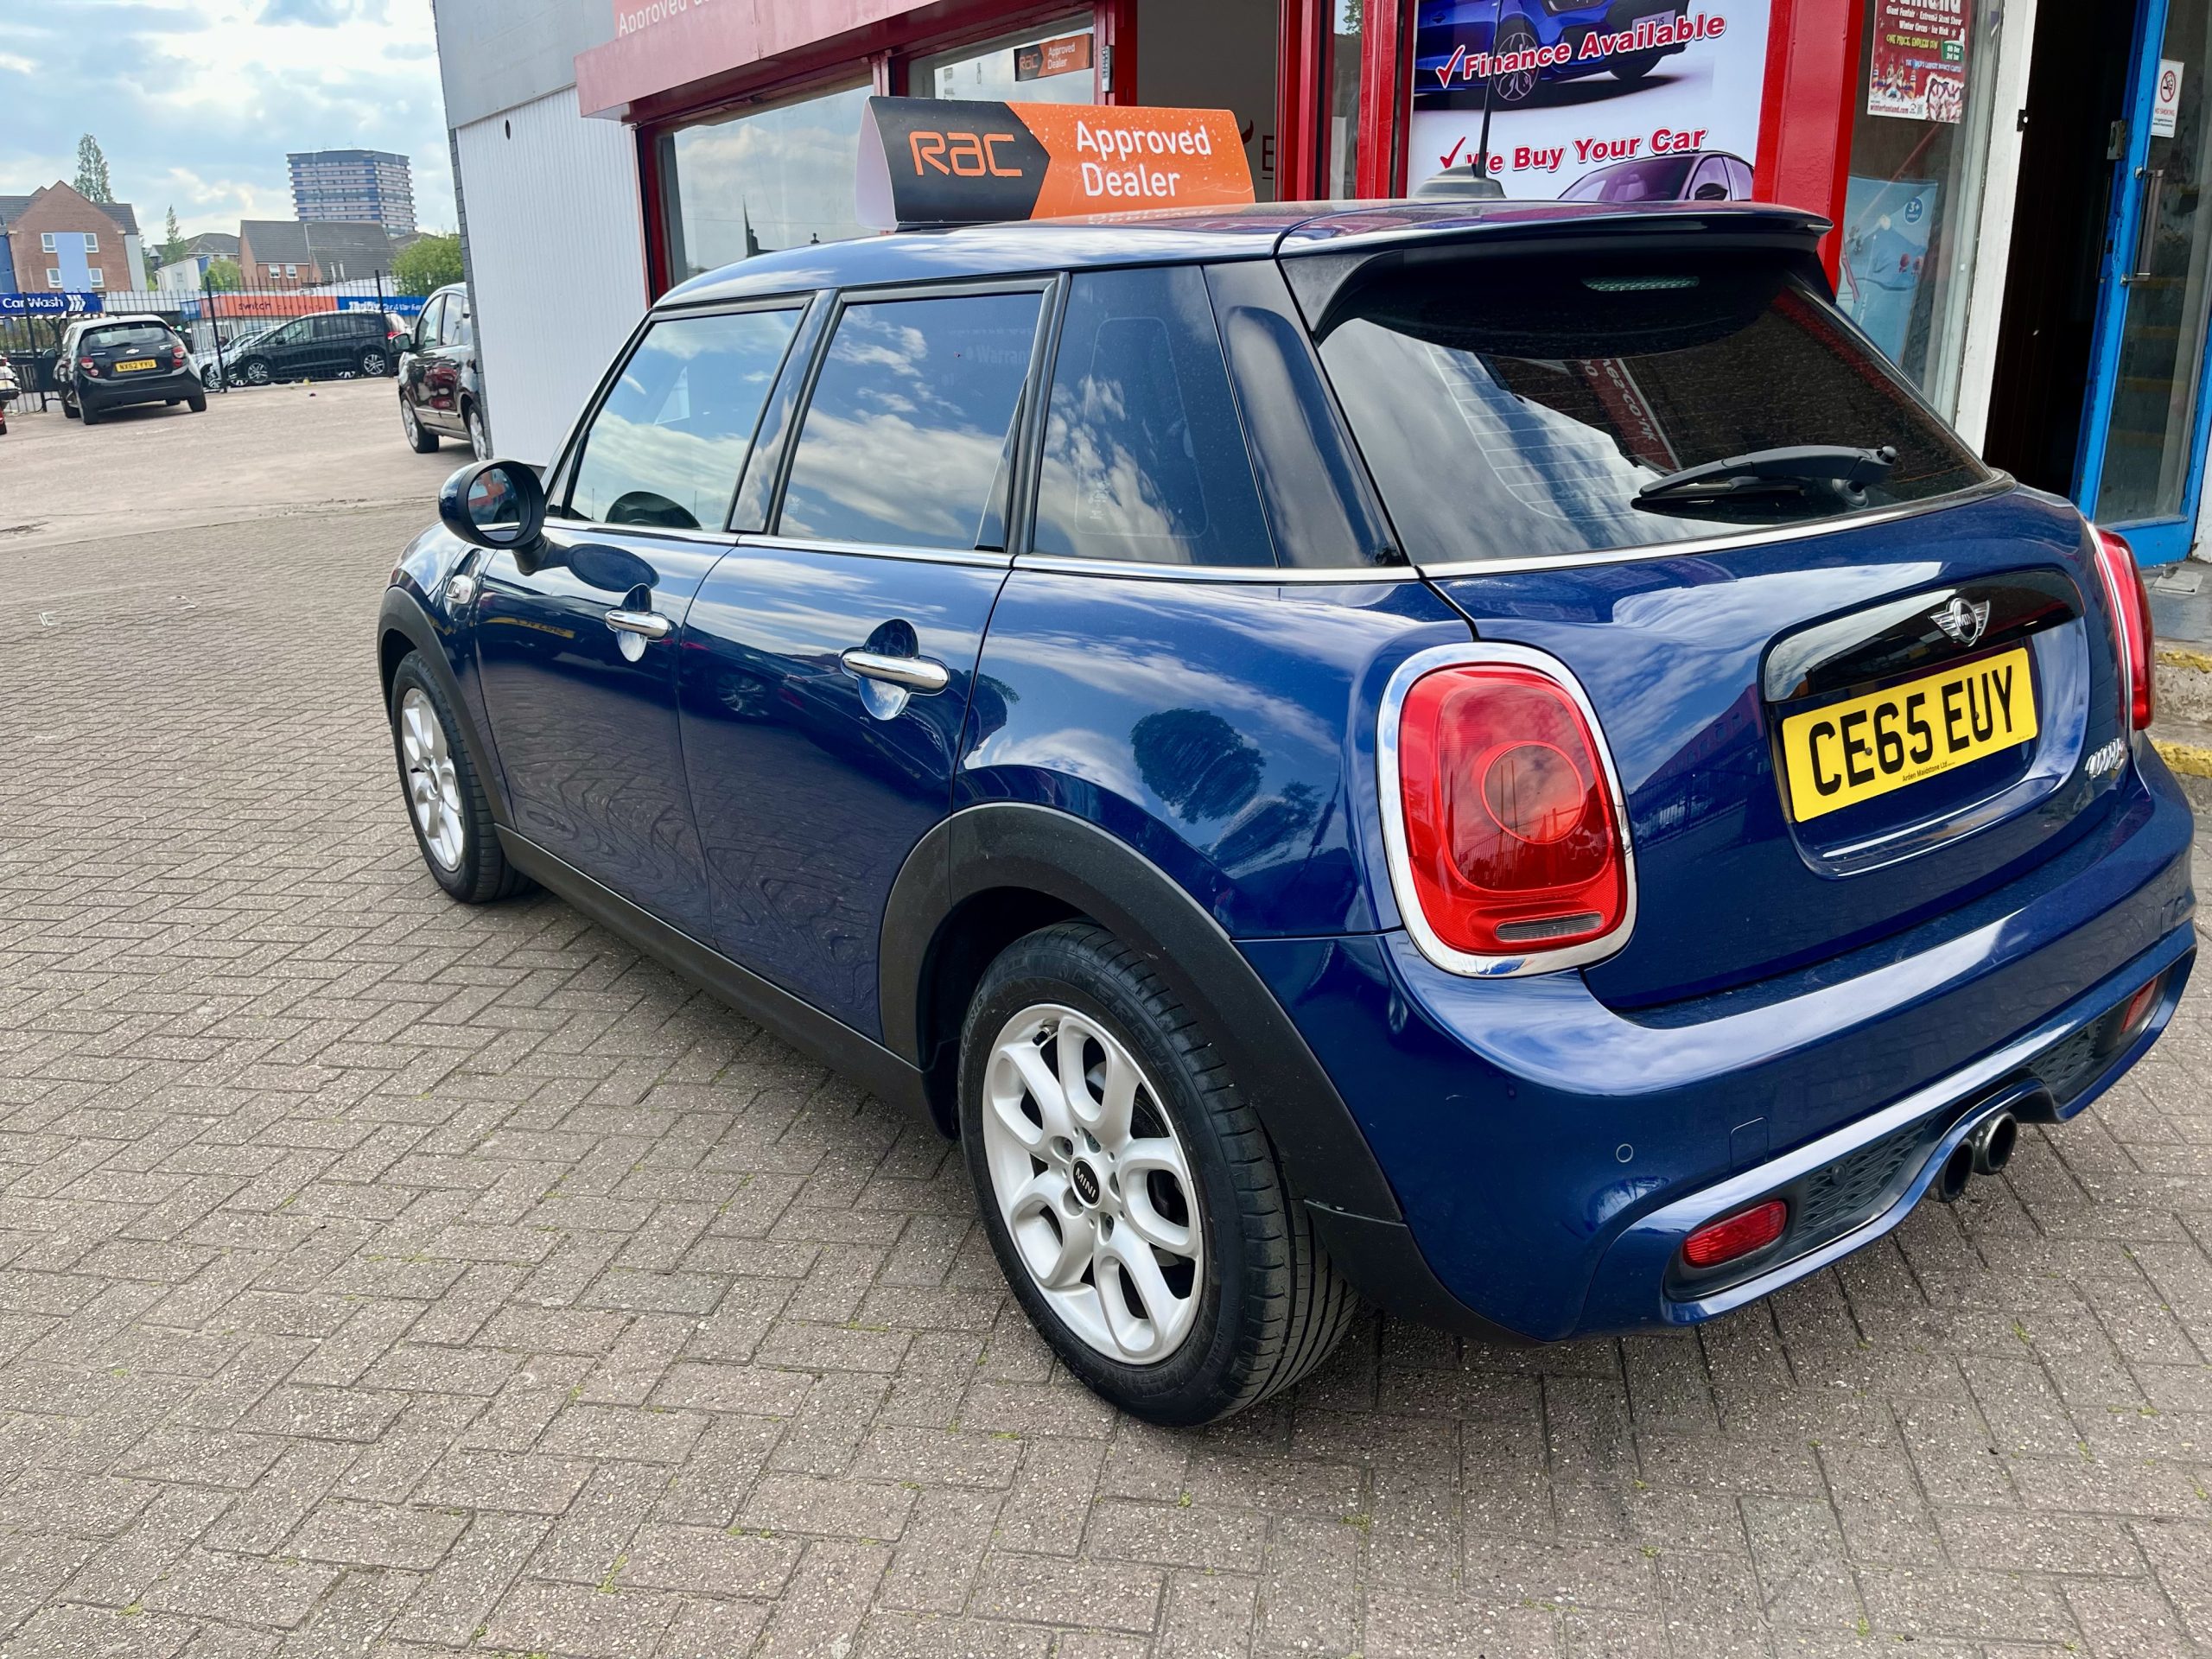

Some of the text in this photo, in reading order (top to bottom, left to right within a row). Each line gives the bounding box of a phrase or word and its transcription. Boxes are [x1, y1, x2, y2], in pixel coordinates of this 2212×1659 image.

[1047, 43, 1077, 57] Approved
[1047, 57, 1068, 70] Dealer
[1463, 13, 1726, 80] Finance Available
[1077, 120, 1211, 162] Approved
[1513, 146, 1565, 174] Buy
[1573, 135, 1642, 164] Your
[1649, 127, 1708, 153] Car
[1081, 162, 1181, 197] Dealer
[2, 296, 64, 308] Car Wash
[1808, 664, 2012, 797] CE65 EUY
[1075, 1166, 1096, 1198] MINI
